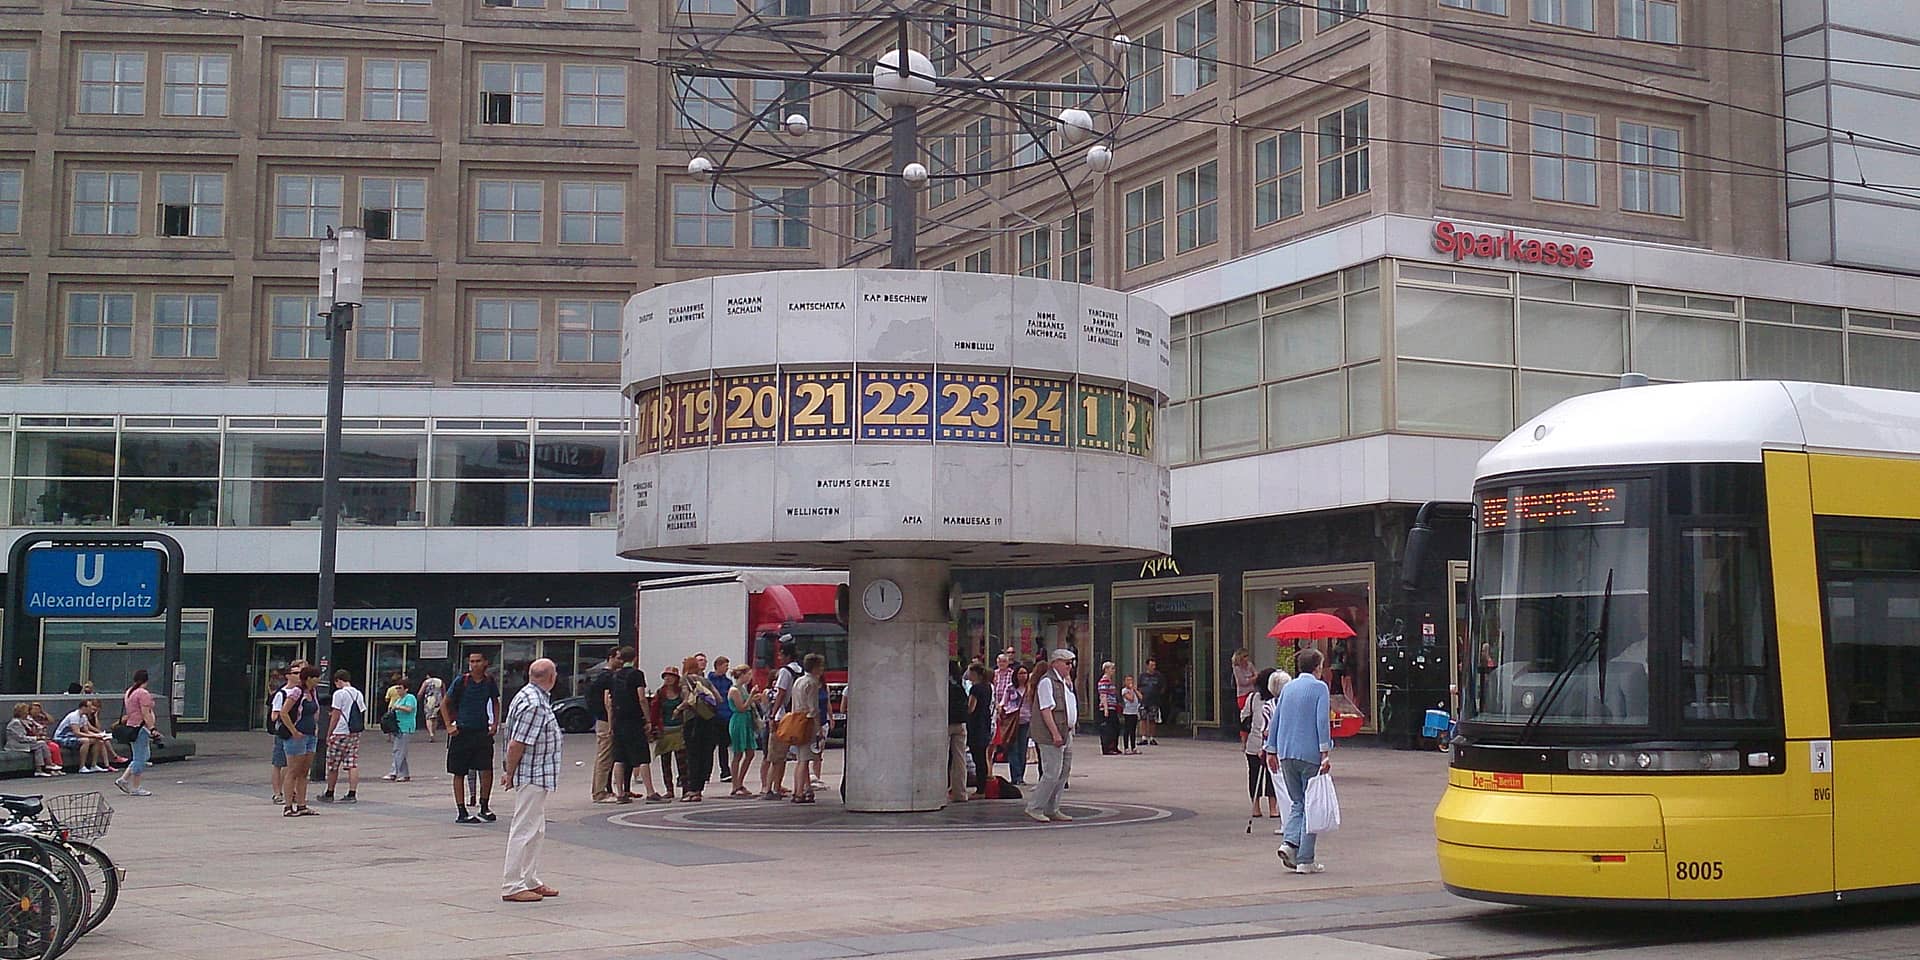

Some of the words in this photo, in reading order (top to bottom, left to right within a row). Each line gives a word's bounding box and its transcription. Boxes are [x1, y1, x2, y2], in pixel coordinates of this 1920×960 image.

[1434, 221, 1594, 269] Sparkasse
[727, 296, 762, 306] MAGADAN
[863, 294, 881, 302] KAP
[884, 294, 928, 303] DESCHNEW
[727, 305, 762, 315] SACHALIN
[788, 301, 846, 311] KAMTSCHATKA
[1036, 312, 1056, 321] NOME
[1025, 328, 1067, 340] ANCHORAGE
[954, 341, 995, 351] HONOLULU
[682, 390, 718, 433] 19
[726, 385, 783, 430] 20
[793, 382, 846, 426] 21
[863, 382, 929, 426] 22
[940, 383, 1000, 428] 23
[1012, 387, 1063, 432] 24
[1082, 395, 1098, 436] 1
[1122, 402, 1136, 443] 2
[817, 479, 851, 488] DATUMS
[854, 479, 891, 488] GRENZE
[786, 507, 840, 516] WELLINGTON
[902, 516, 923, 524] APIA
[943, 516, 991, 525] MARQUESAS
[75, 553, 105, 587] U
[29, 591, 152, 611] Alexanderplatz
[478, 615, 617, 630] ALEXANDERHAUS
[1813, 787, 1831, 801] BVG
[1676, 861, 1724, 881] 8005
